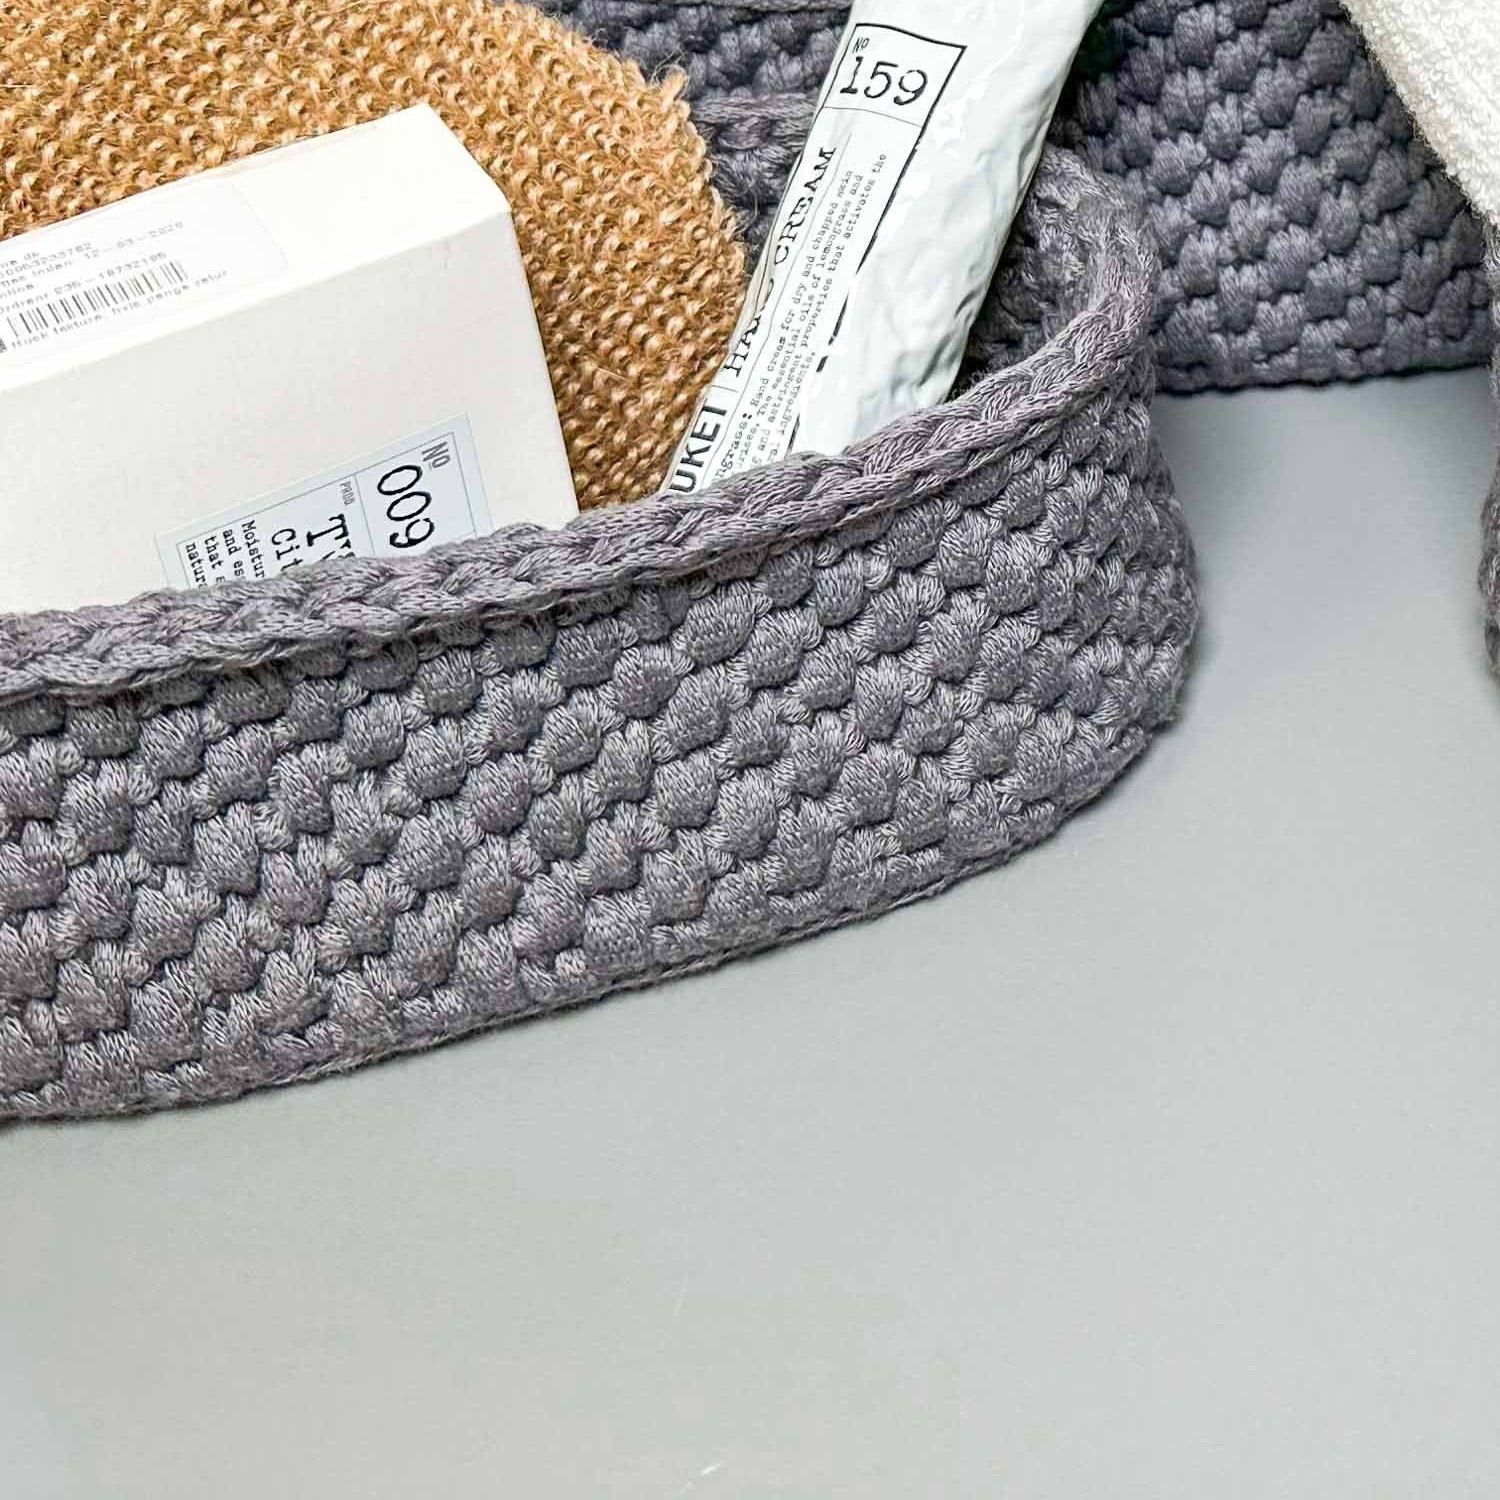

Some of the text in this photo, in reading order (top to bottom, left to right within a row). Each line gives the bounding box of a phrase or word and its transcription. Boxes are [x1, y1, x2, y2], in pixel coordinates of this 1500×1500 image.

[839, 56, 928, 105] 159
[774, 147, 836, 265] CREAM
[828, 244, 845, 271] that
[871, 154, 887, 174] the
[850, 174, 864, 196] and
[780, 309, 795, 331] for
[790, 281, 807, 304] dry
[801, 255, 815, 277] and
[812, 202, 838, 250] chapped
[377, 464, 435, 548] 009
[204, 535, 224, 570] that
[223, 529, 242, 556] and
[241, 519, 265, 579] Moistur
